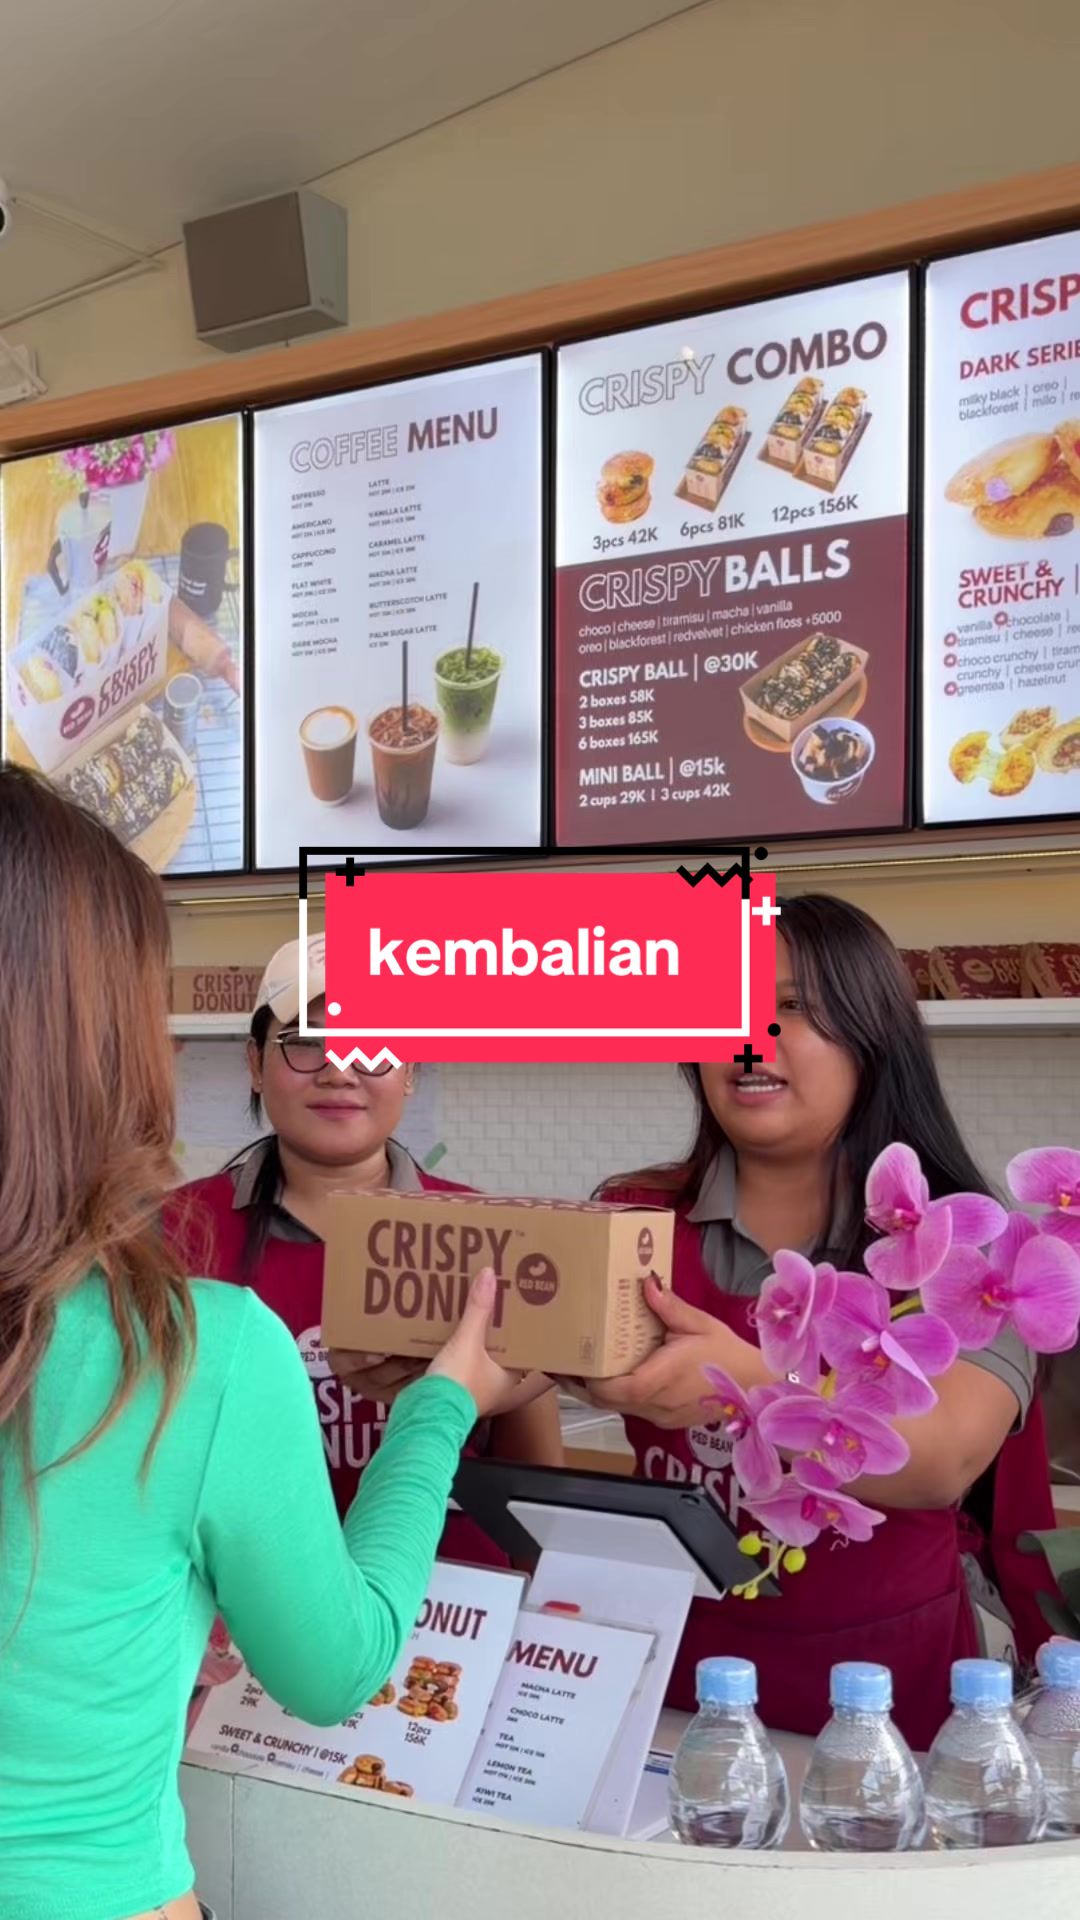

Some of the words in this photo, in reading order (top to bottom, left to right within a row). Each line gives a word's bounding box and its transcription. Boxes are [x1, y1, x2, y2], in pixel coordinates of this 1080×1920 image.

[578, 354, 715, 415] CRISPY
[727, 321, 887, 385] COMBO
[960, 350, 1020, 379] DARK
[959, 393, 988, 409] milky
[990, 386, 1020, 402] black
[1032, 380, 1059, 394] oreo
[959, 401, 1019, 421] blackforest
[1032, 393, 1057, 407] milo
[290, 424, 398, 473] COFFEE
[407, 407, 498, 453] MENU
[368, 478, 390, 488] LATTE
[399, 504, 421, 513] LATTE
[772, 504, 815, 523] 12pcs
[819, 494, 858, 515] 156K
[680, 520, 714, 537] 6pcs
[717, 512, 745, 531] 81K
[368, 538, 402, 548] CARAMEL
[592, 534, 624, 551] 3pcs
[627, 527, 658, 544] 42K
[396, 566, 417, 575] LATTE
[579, 557, 721, 612] CRISPY
[725, 538, 851, 593] BALLS
[958, 561, 1030, 588] SWEET
[1035, 559, 1053, 578] &
[425, 592, 448, 602] LATTE
[958, 577, 1065, 609] CRUNCHY
[578, 624, 611, 637] choco
[617, 619, 655, 632] cheese
[662, 612, 705, 627] tiramisu
[712, 606, 749, 620] macha
[756, 600, 793, 614] vanilla
[415, 624, 437, 634] LATTE
[578, 642, 602, 654] oreo
[609, 633, 667, 650] blackforest
[673, 626, 723, 642] redvelvet
[731, 621, 774, 635] chicken
[776, 618, 803, 629] floss
[806, 610, 842, 625] +5000
[1012, 626, 1054, 641] cheese
[993, 649, 1038, 664] crunchy
[579, 665, 641, 688] CRISPY
[644, 659, 688, 681] BALL
[704, 651, 759, 674] @30K
[957, 667, 1002, 682] crunchy
[1014, 662, 1055, 675] cheese
[1018, 673, 1067, 688] hazelnut
[579, 696, 588, 708] 2
[590, 692, 626, 707] boxes
[629, 689, 655, 703] 58K
[579, 716, 588, 729] 3
[589, 712, 626, 728] boxes
[628, 709, 654, 724] 85K
[578, 737, 588, 751] 6
[589, 734, 626, 749] boxes
[628, 730, 659, 745] 165K
[579, 767, 618, 786] MINI
[622, 762, 664, 782] BALL
[679, 756, 726, 778] @15k
[579, 795, 588, 807] 2
[589, 794, 617, 808] cups
[620, 788, 646, 803] 29K
[661, 788, 670, 800] 3
[671, 788, 700, 803] cups
[703, 783, 730, 798] 42K
[193, 974, 256, 992] CRISPY
[193, 993, 257, 1012] DONUT
[367, 1220, 513, 1276] CRISPY
[414, 1598, 488, 1640] ONUT
[505, 1640, 598, 1678] MENU
[551, 1689, 577, 1700] LATTE
[510, 1706, 539, 1719] CHOCO
[539, 1713, 565, 1725] LATTE
[407, 1721, 432, 1737] 12pcs
[499, 1732, 515, 1742] TEA
[219, 1724, 254, 1741] SWEET
[252, 1732, 263, 1744] &
[263, 1735, 314, 1756] CRUNCHY
[319, 1748, 349, 1765] @15K
[403, 1732, 428, 1747] 156K
[486, 1760, 516, 1772] LEMON
[517, 1766, 533, 1776] TEA
[496, 1791, 513, 1801] TEA
